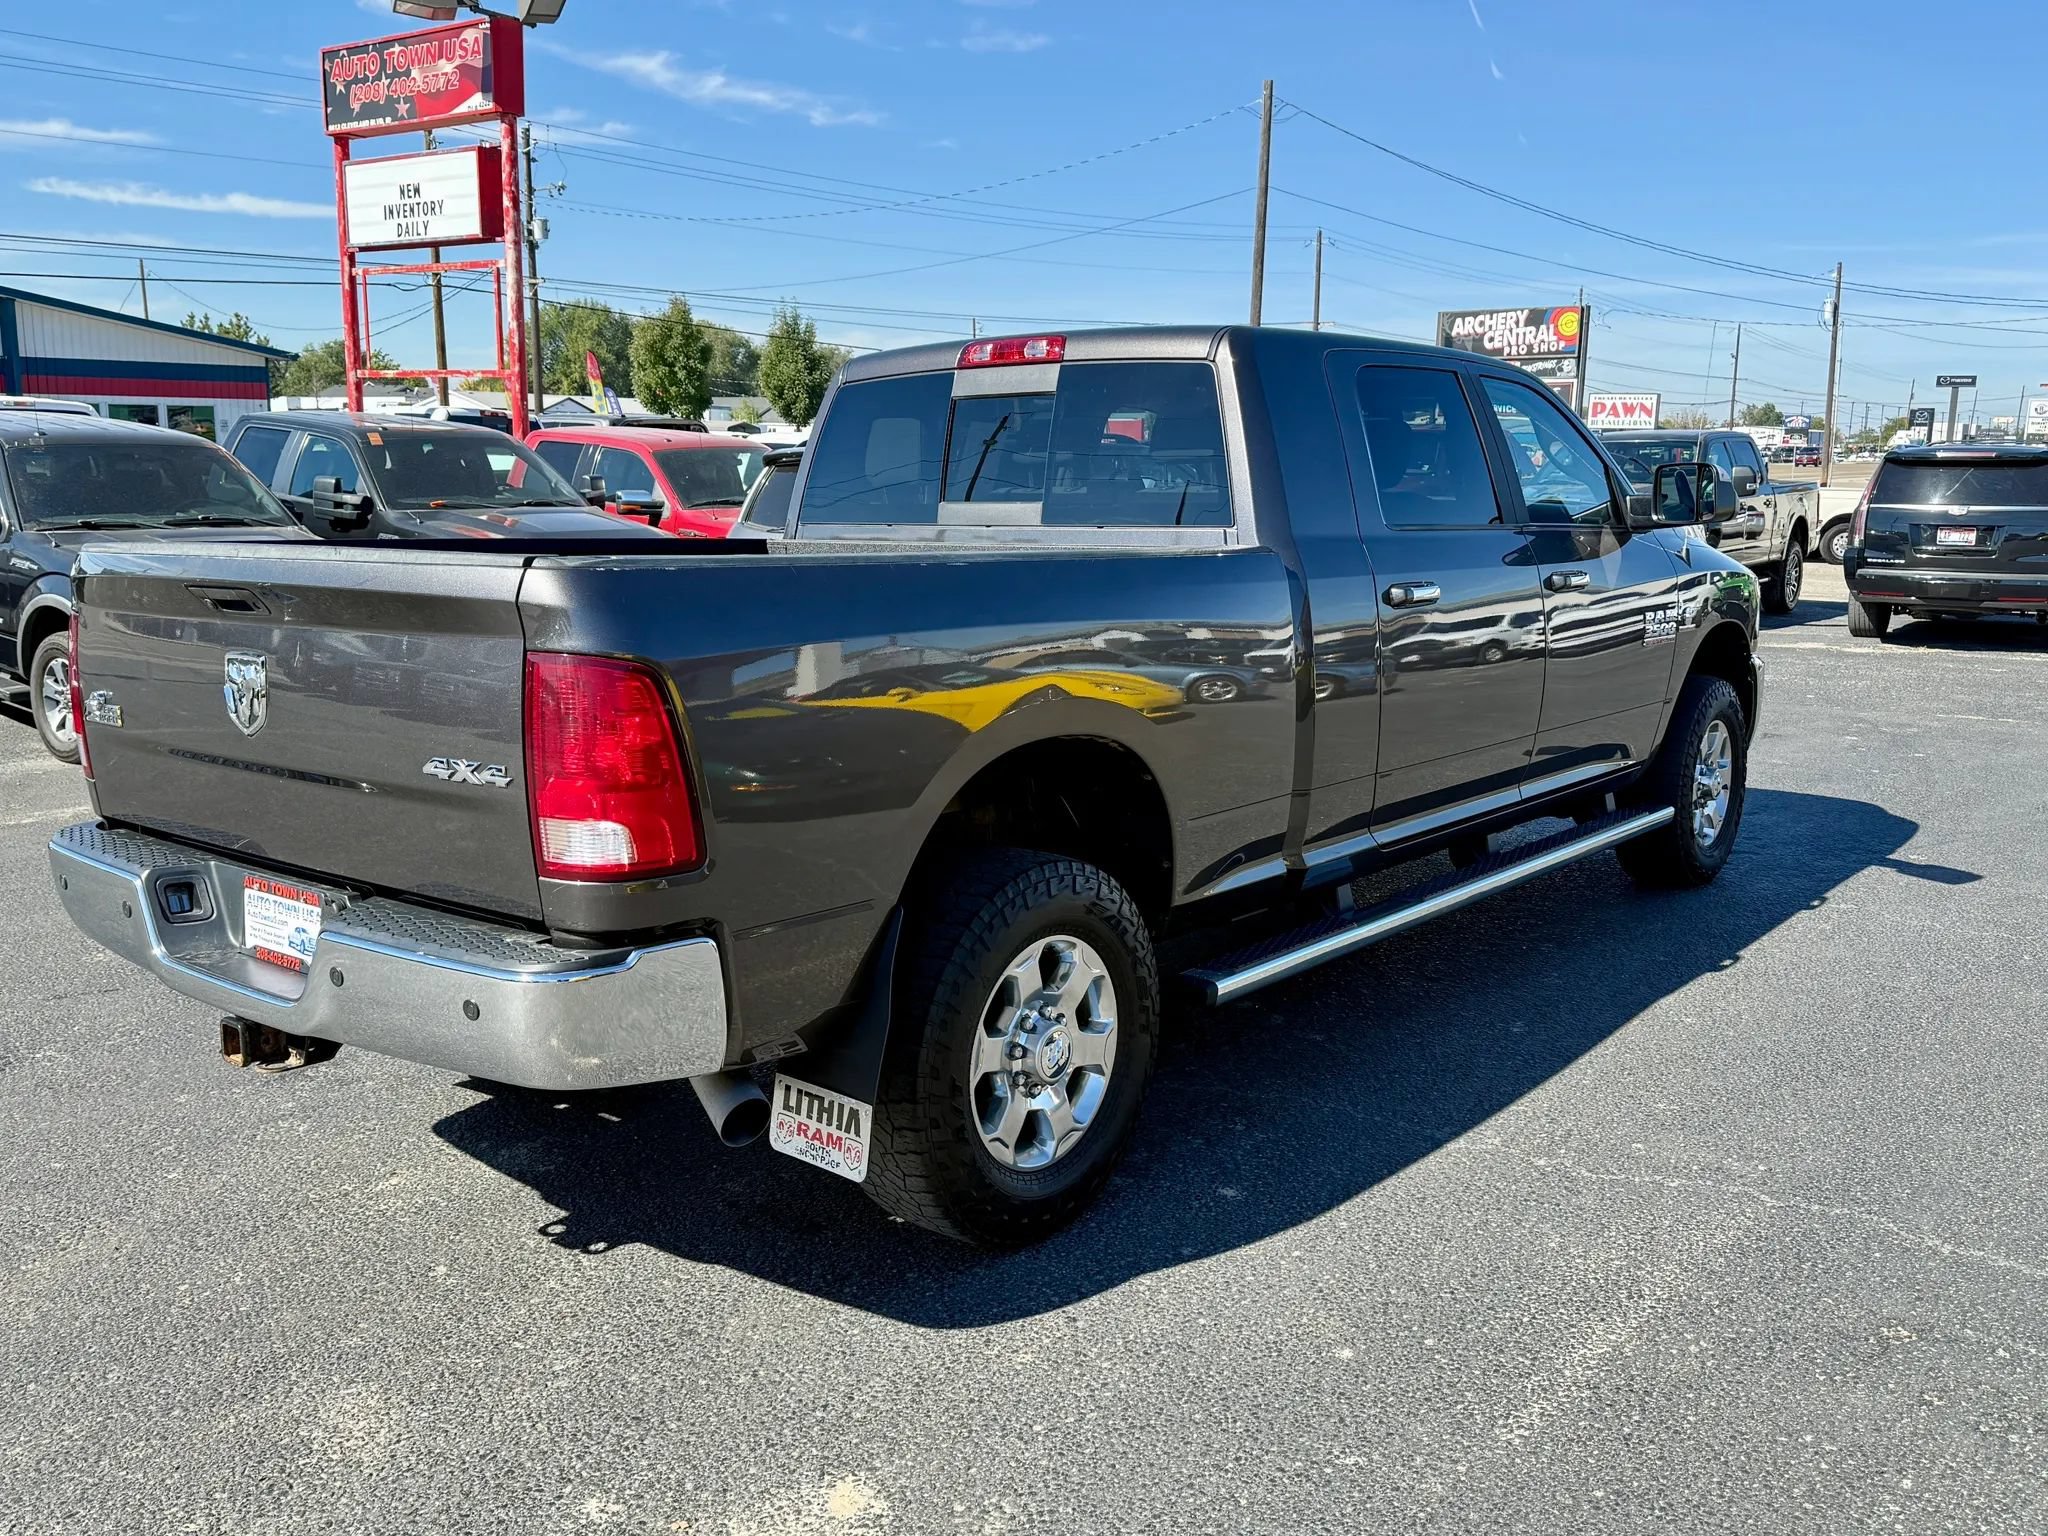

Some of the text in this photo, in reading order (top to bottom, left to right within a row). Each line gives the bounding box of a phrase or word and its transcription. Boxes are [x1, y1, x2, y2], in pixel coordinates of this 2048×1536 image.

[330, 33, 483, 82] AUTO TOWN USA
[349, 70, 460, 109] (208) 402-5772
[399, 182, 421, 200] NEW
[383, 199, 444, 221] INVENTORY
[396, 219, 430, 238] DAILY
[1451, 309, 1530, 338] ARCHERY
[1483, 323, 1558, 351] CENTRAL
[1503, 340, 1566, 357] PRO SHOP
[1591, 401, 1654, 419] PAWN
[1645, 609, 1678, 623] RAM
[243, 875, 320, 906] AUTO TOWN USA
[247, 893, 271, 911] AUTO
[256, 947, 301, 970] 208-402-5772
[782, 1083, 861, 1138] LITHIA
[796, 1120, 844, 1153] RAM
